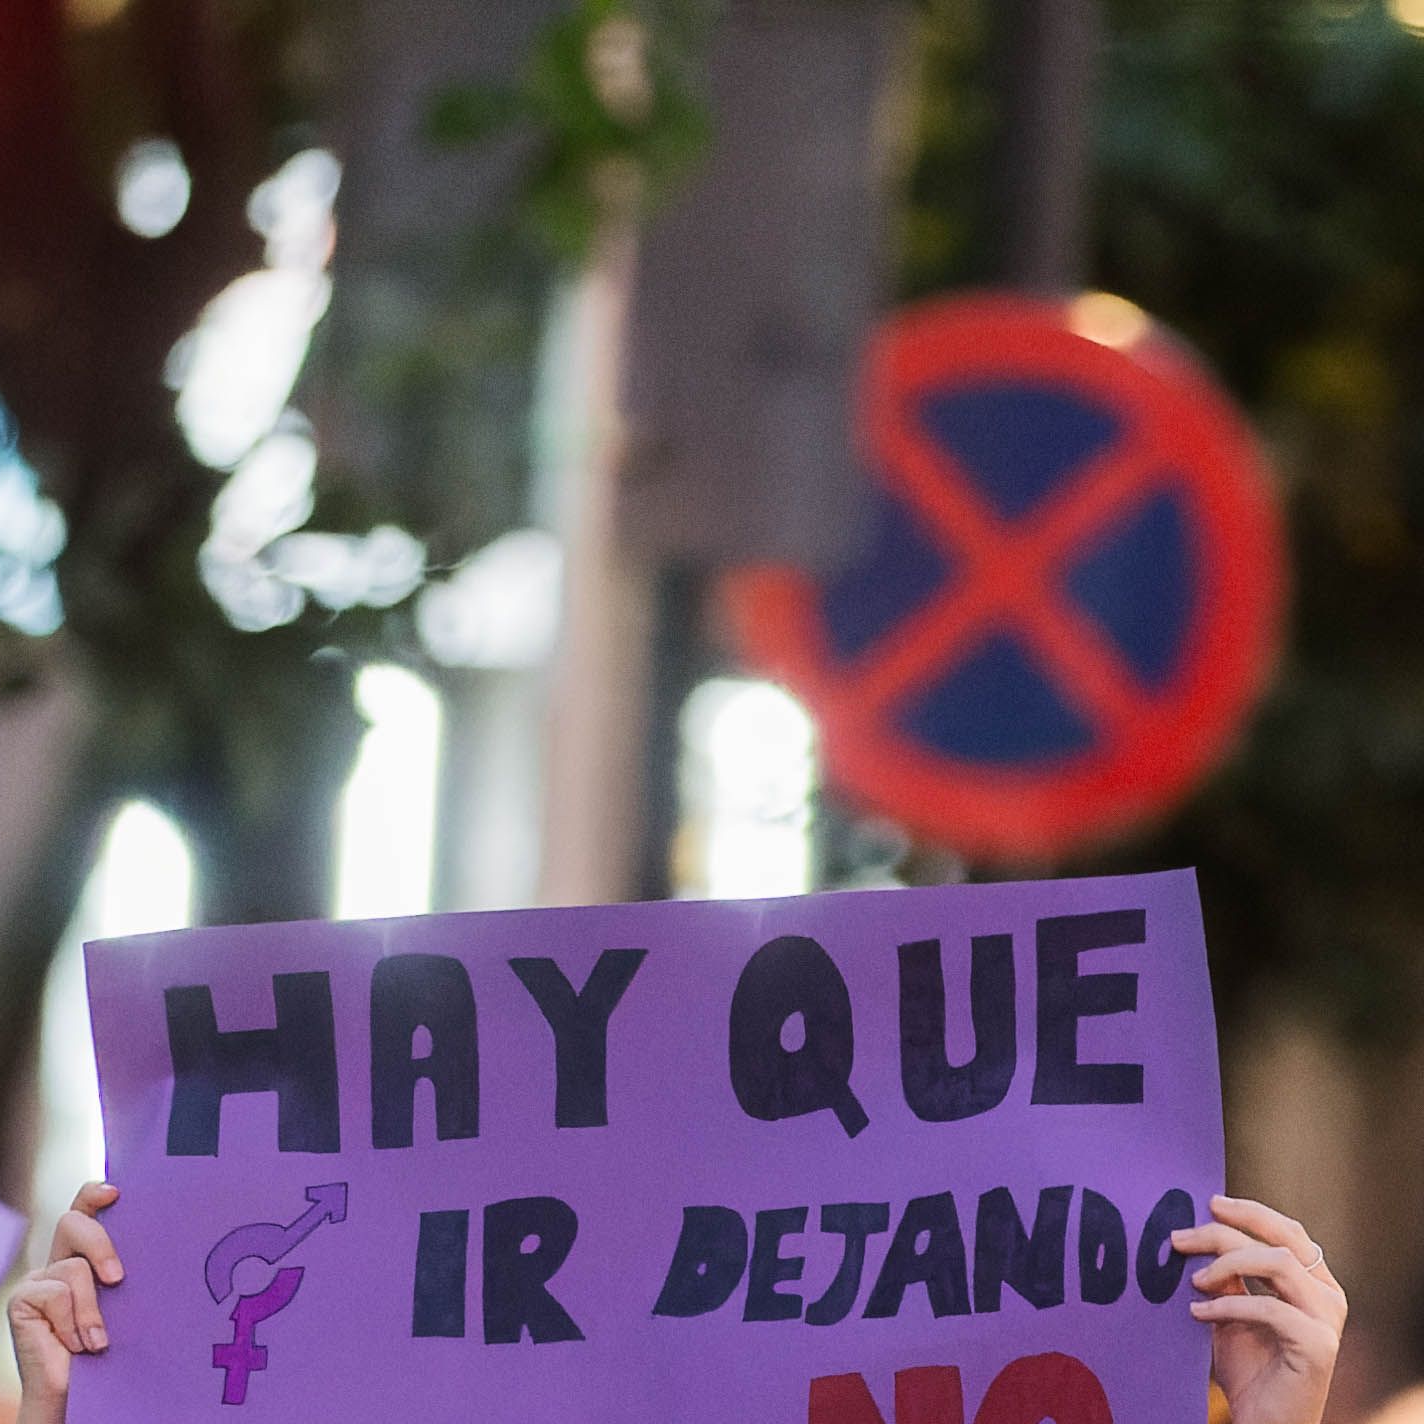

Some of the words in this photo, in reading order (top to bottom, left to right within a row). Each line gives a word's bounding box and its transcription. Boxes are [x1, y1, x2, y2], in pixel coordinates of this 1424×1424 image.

[164, 948, 649, 1156] HAY
[729, 909, 1146, 1138] QUE
[412, 1196, 585, 1345] IR
[652, 1186, 1196, 1326] DEJANDO
